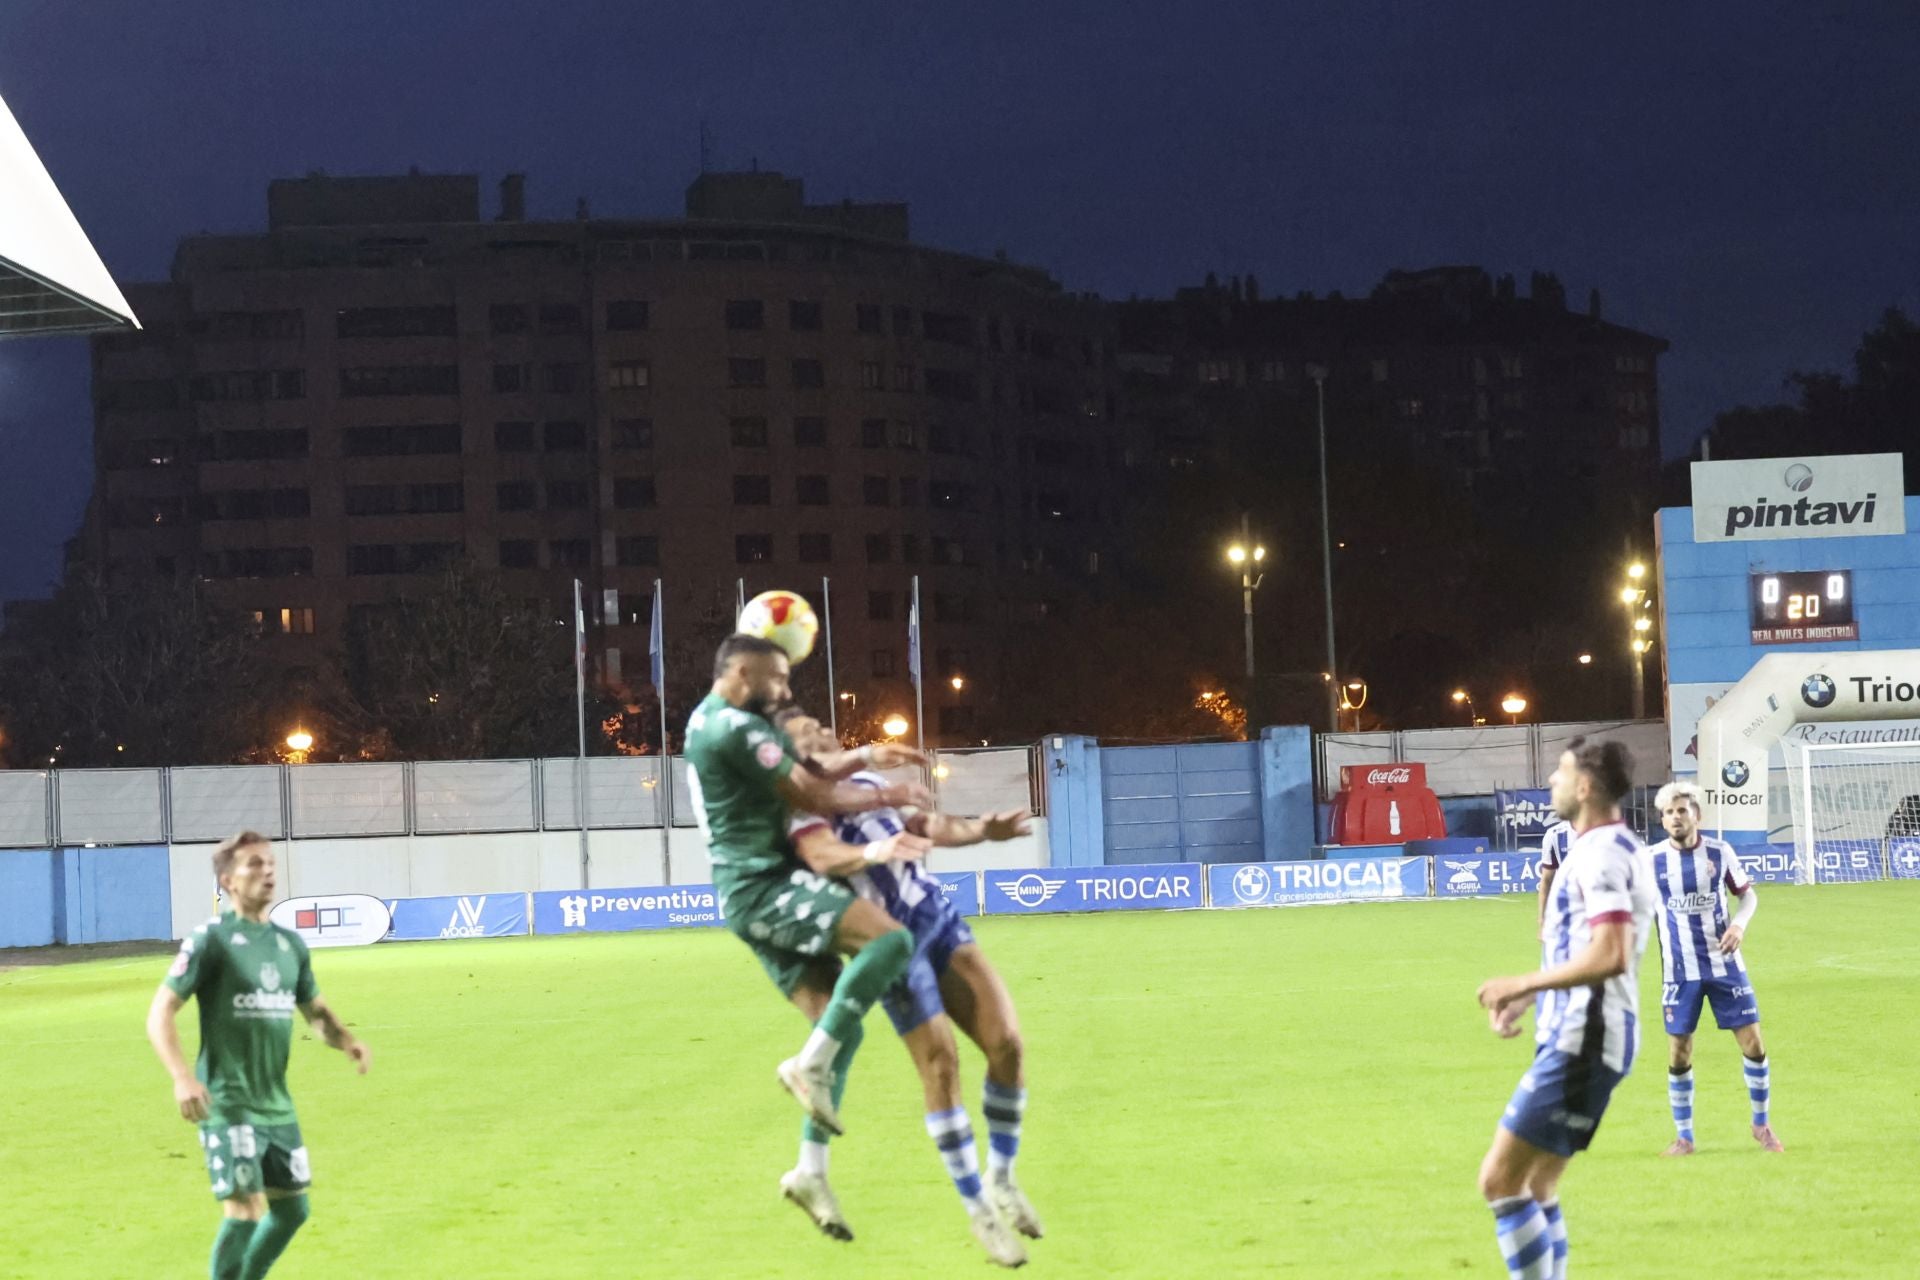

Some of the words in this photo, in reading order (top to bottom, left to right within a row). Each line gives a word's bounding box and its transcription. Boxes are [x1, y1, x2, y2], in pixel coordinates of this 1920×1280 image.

[1725, 493, 1876, 536] pintavi
[1762, 578, 1779, 604] 0
[1827, 575, 1844, 600] 0
[1788, 594, 1819, 619] 20
[1795, 724, 1920, 745] Restaurant
[1705, 789, 1763, 805] Triocar
[1273, 862, 1402, 889] TRIOCAR
[1488, 861, 1512, 881] EL
[1020, 887, 1042, 896] MINI
[1076, 876, 1191, 901] TRIOCAR
[1502, 883, 1527, 893] DEL
[591, 890, 714, 913] Preventiva
[668, 912, 715, 924] Seguros
[1662, 983, 1679, 1005] 22
